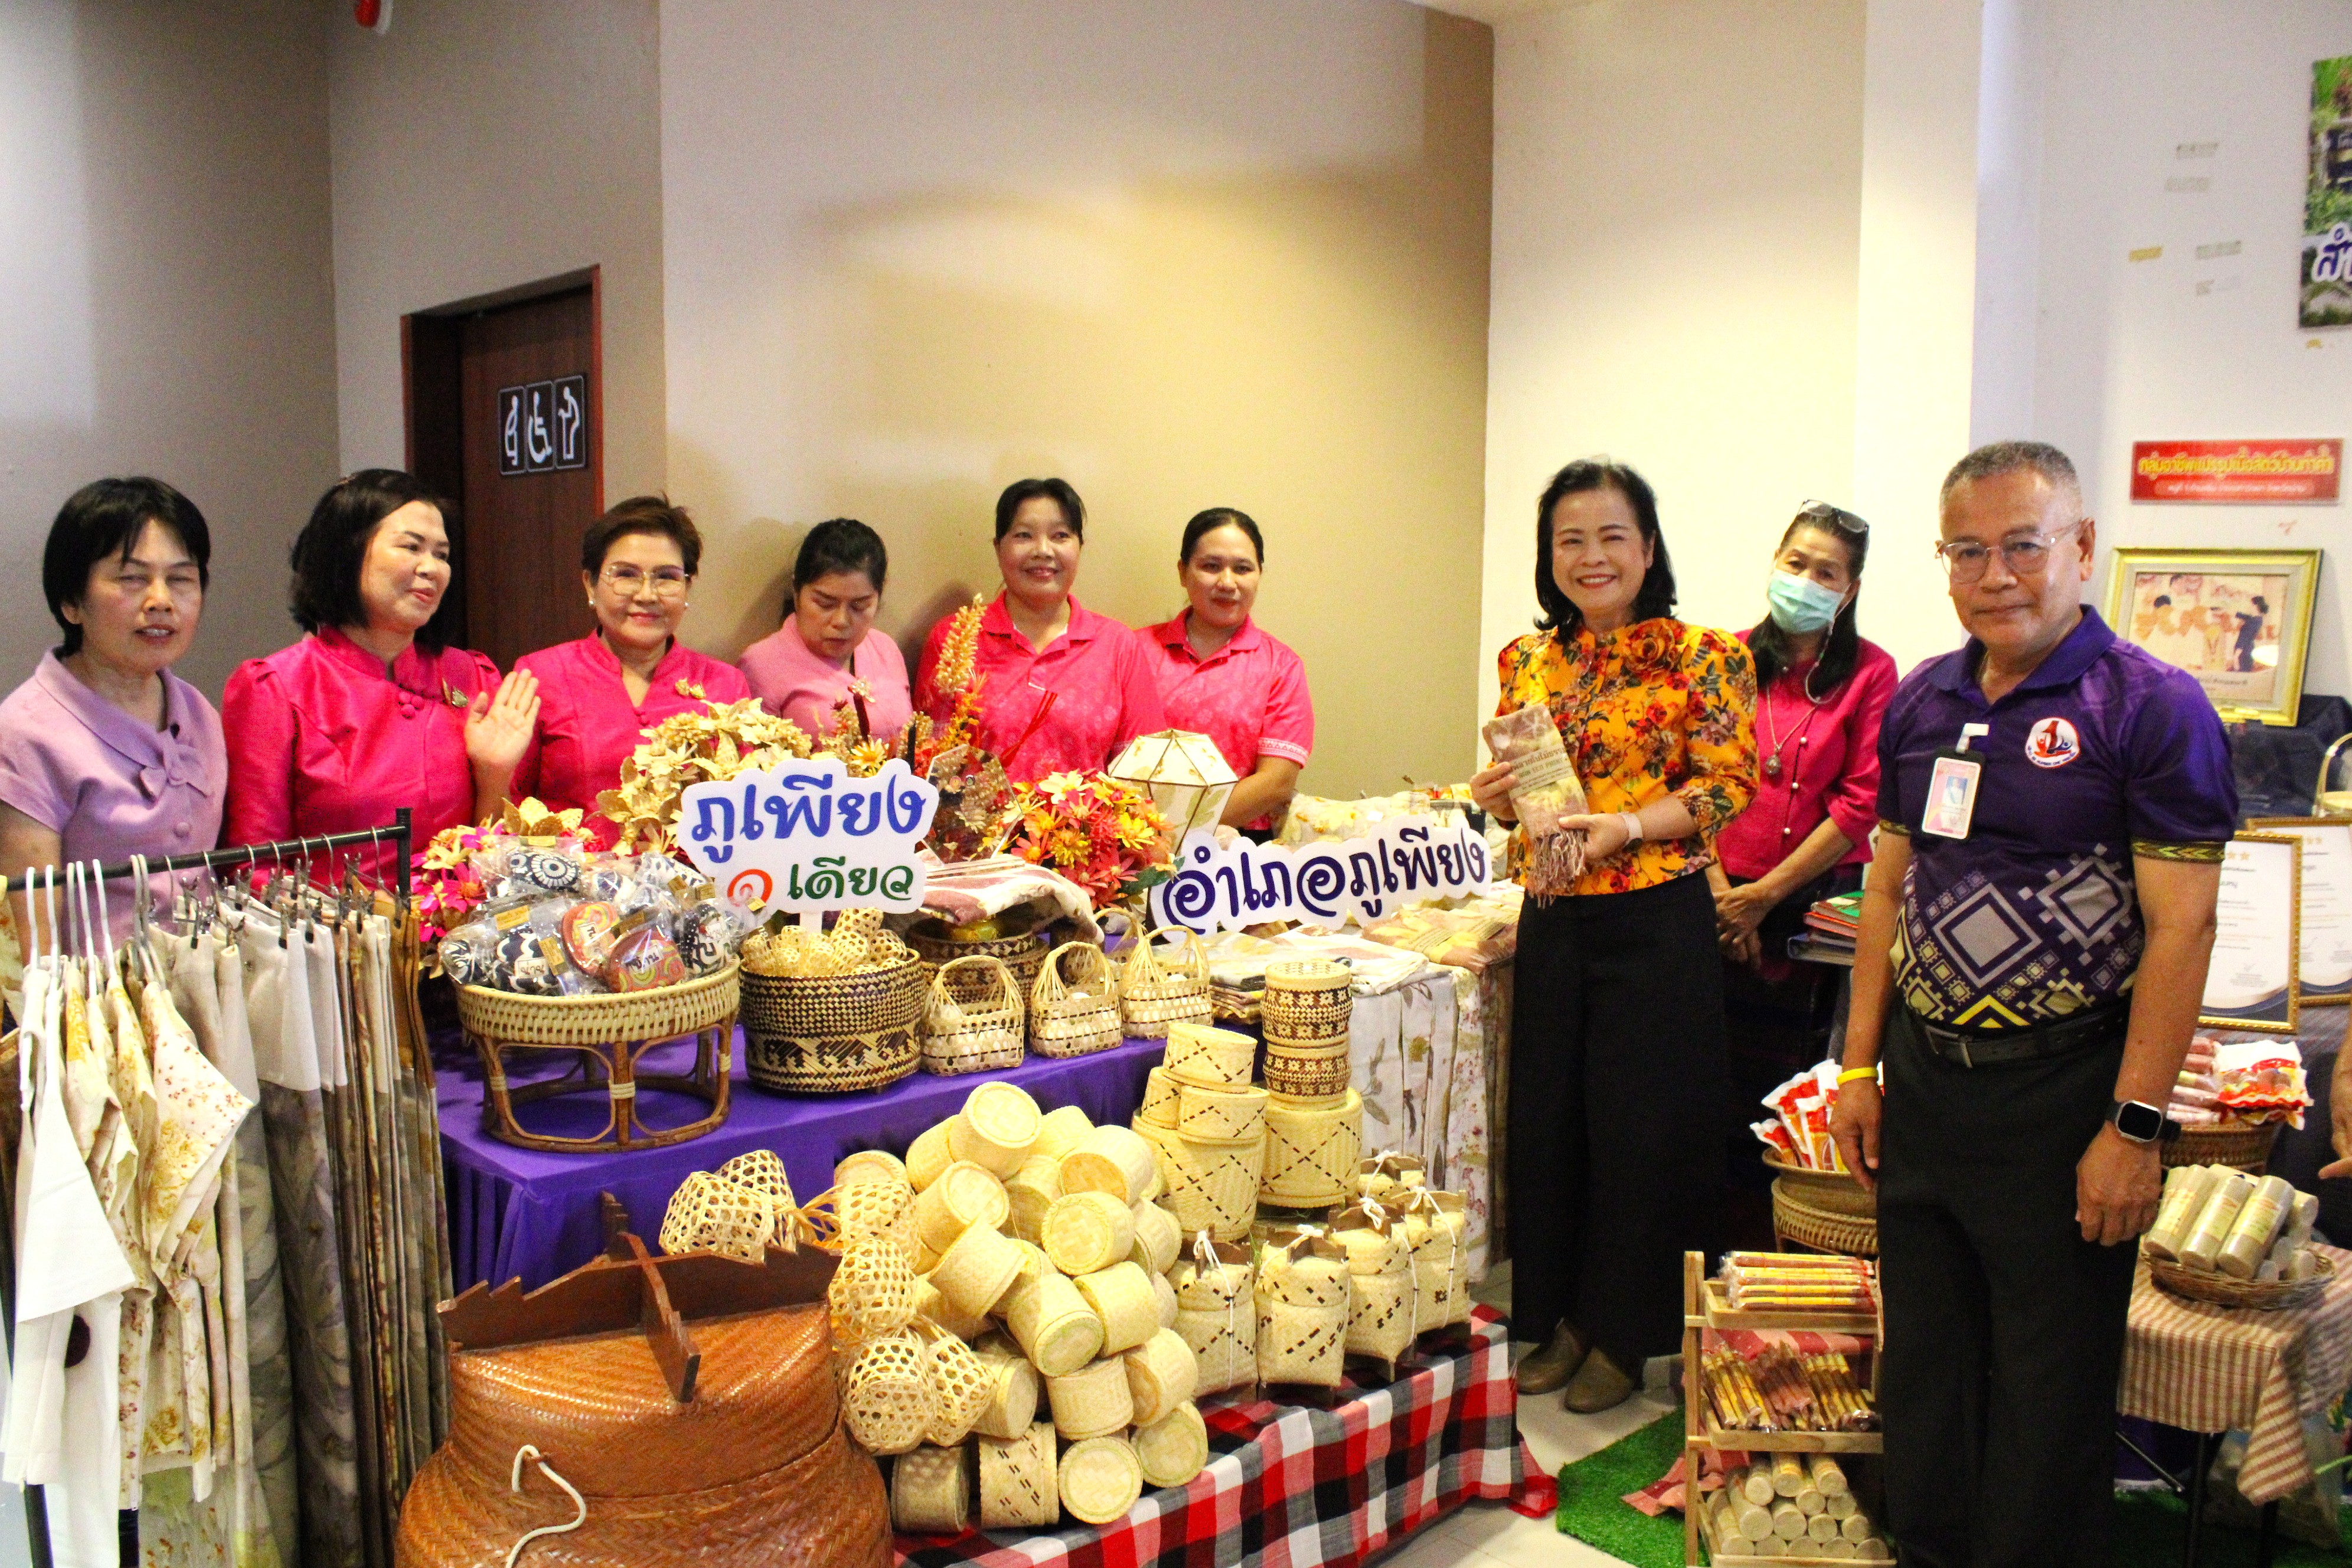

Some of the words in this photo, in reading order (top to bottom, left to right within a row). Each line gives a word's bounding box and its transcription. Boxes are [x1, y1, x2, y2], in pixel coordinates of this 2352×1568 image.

[692, 774, 926, 863] ภูเพียง
[788, 856, 914, 901] เดียว
[1163, 827, 1485, 935] อำเภอภูเพียง
